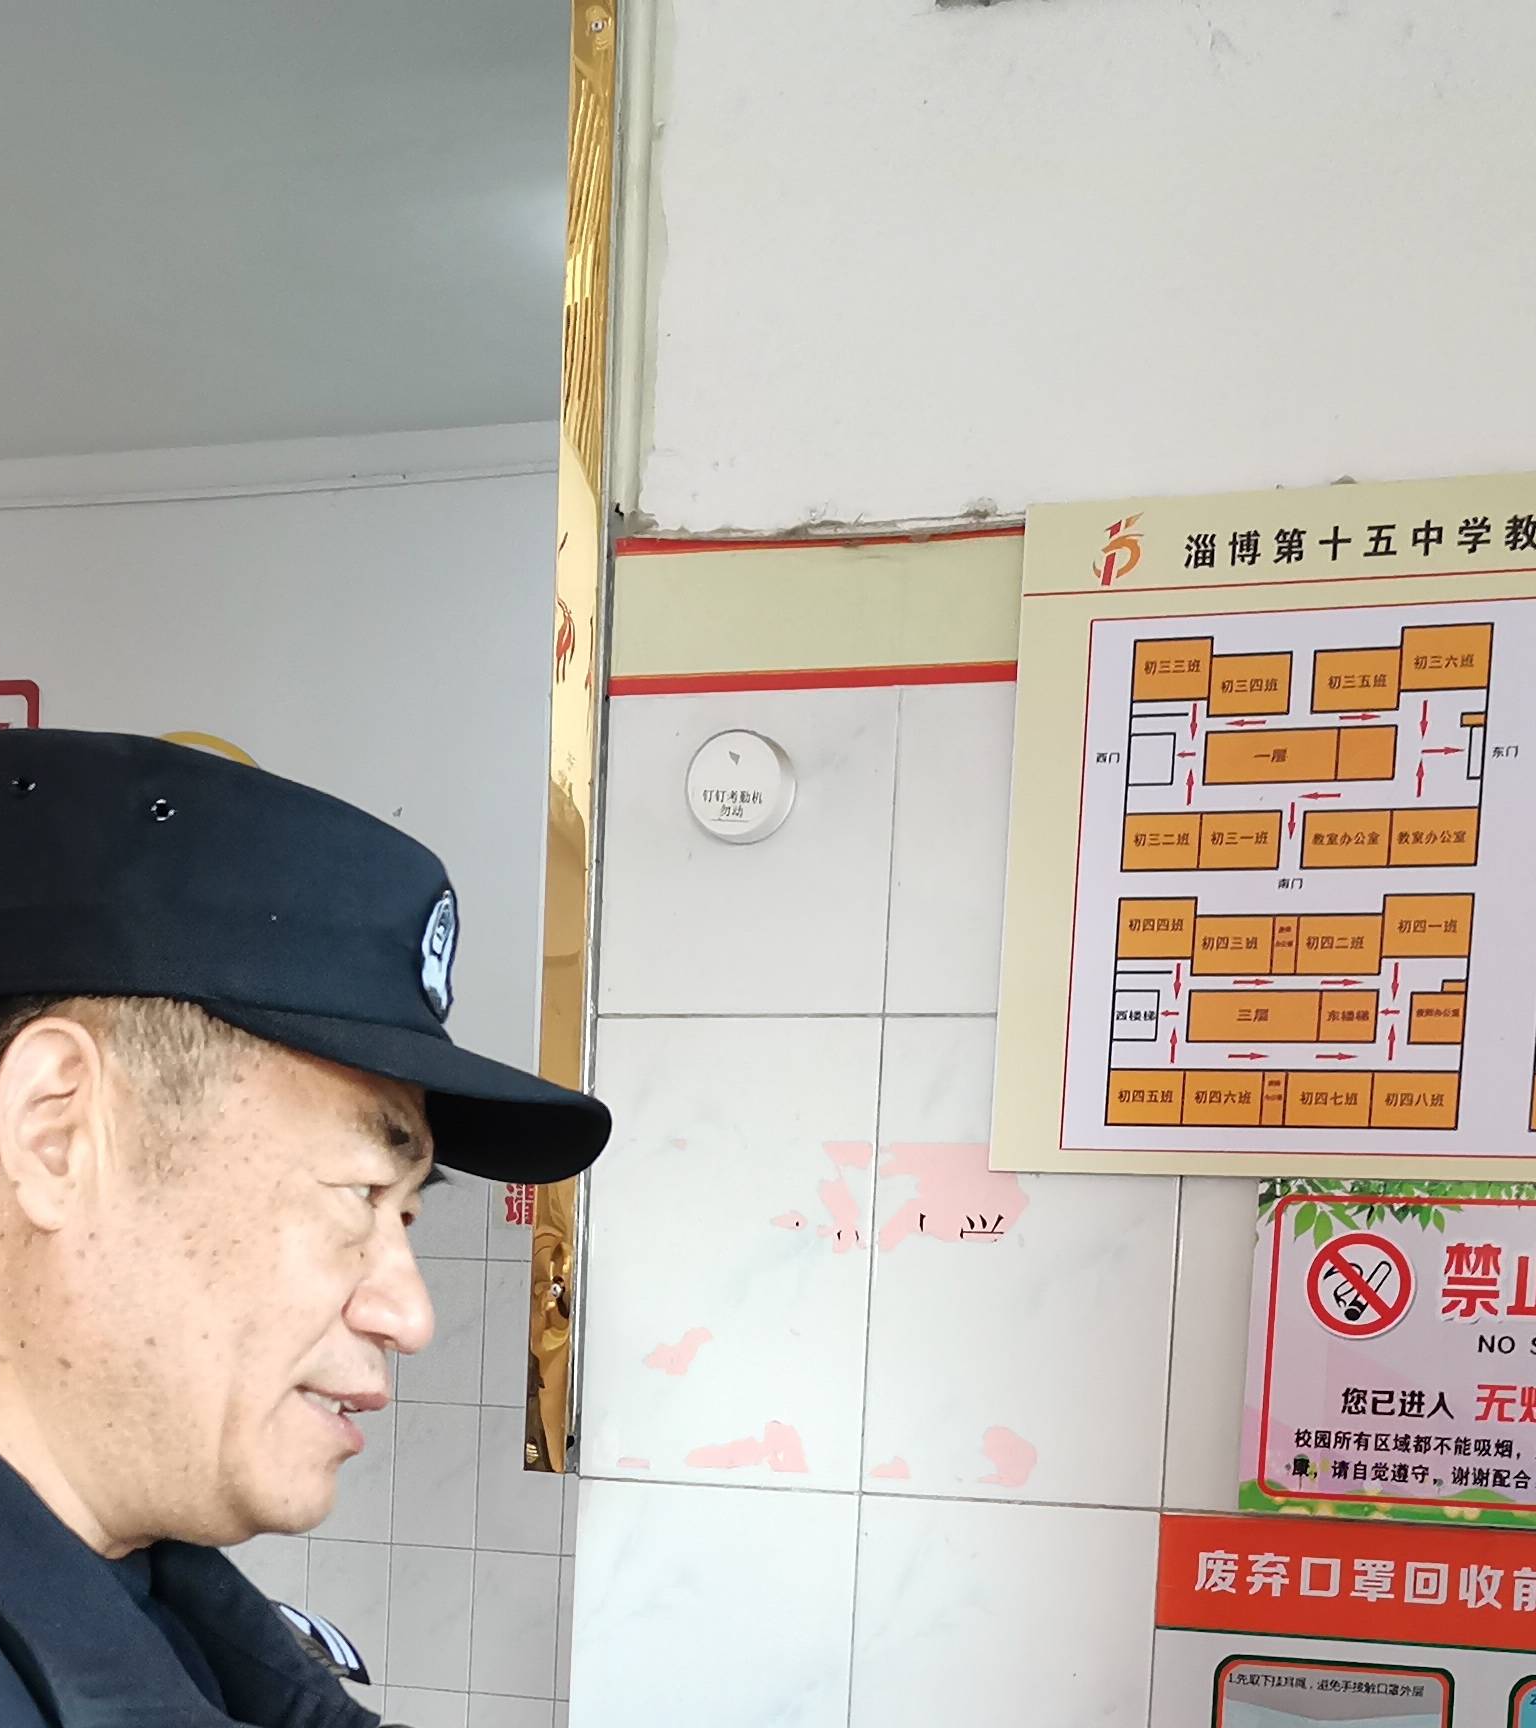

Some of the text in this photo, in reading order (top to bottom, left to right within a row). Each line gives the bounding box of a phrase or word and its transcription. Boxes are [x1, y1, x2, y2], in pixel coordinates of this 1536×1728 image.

[1144, 658, 1202, 676] 初三三班
[1413, 653, 1475, 670] 初三六班
[1221, 678, 1279, 694] 初三四班
[1328, 673, 1388, 690] 初三五班
[1096, 751, 1120, 765] 西门
[1254, 748, 1288, 763] 一层
[1491, 745, 1519, 759] 东门
[1134, 832, 1190, 847] 初三二班
[1210, 830, 1269, 846] 初三一班
[1277, 877, 1303, 890] 南门
[1128, 918, 1184, 933] 初四四班
[1397, 918, 1458, 935] 初四一班
[1201, 935, 1258, 951] 初四三班
[1305, 935, 1364, 951] 初四二班
[1115, 1008, 1157, 1022] 西楼梯
[1236, 1008, 1270, 1023] 三层
[1326, 1008, 1370, 1022] 东楼梯
[1118, 1088, 1174, 1104] 初四五班
[1194, 1089, 1251, 1105] 初四六班
[1300, 1090, 1358, 1106] 初四七班
[1384, 1092, 1444, 1108] 初四八班
[1478, 1335, 1515, 1355] NO
[1341, 1387, 1454, 1420] 您已进入
